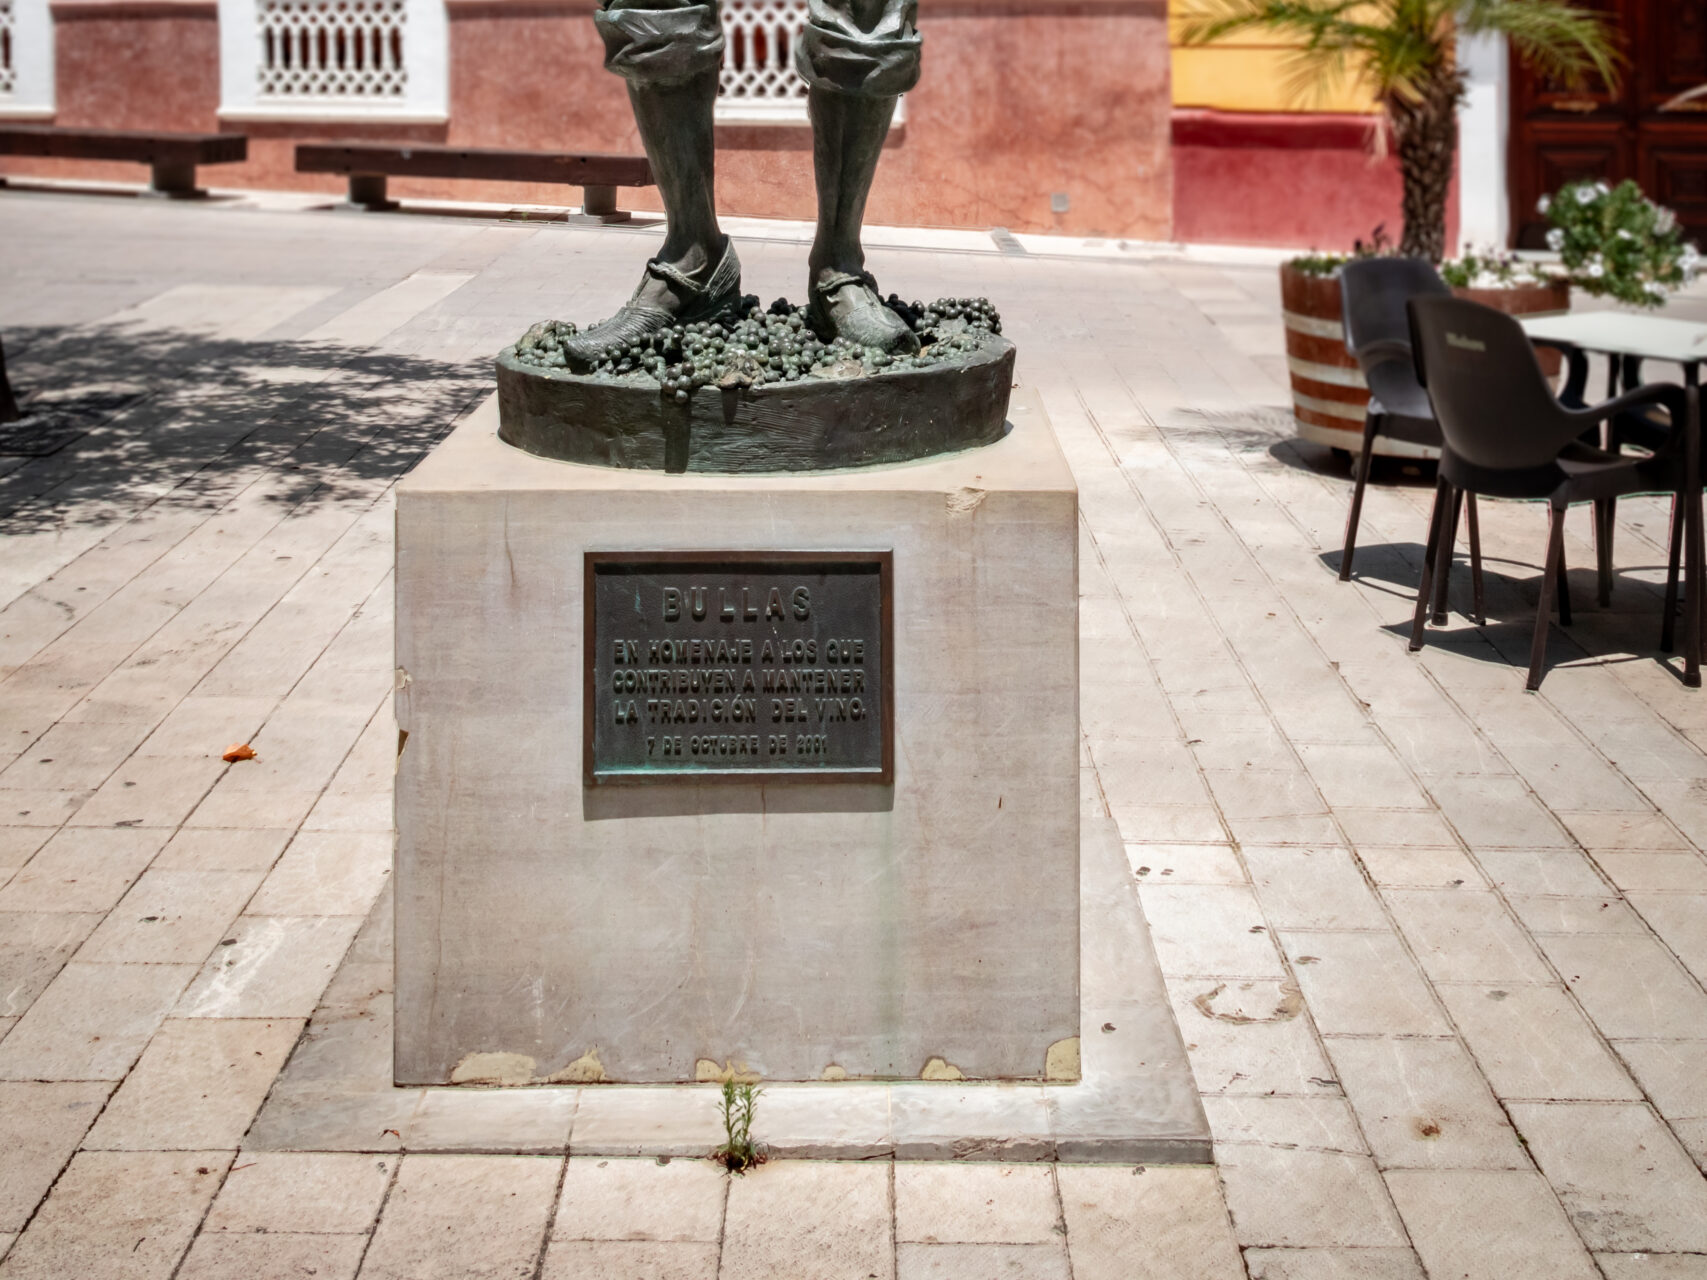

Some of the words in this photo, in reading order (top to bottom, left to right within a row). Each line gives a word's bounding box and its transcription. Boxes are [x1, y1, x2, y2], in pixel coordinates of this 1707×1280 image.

[663, 586, 811, 620] BULLAS
[614, 639, 639, 663] EN
[648, 639, 752, 663] HOMENAJE
[761, 639, 774, 663] A
[782, 639, 817, 663] LOS
[826, 638, 864, 663] QUE
[613, 669, 736, 693] CONTRIBUYEN
[742, 669, 755, 693] A
[761, 669, 865, 693] MANTENER
[614, 699, 639, 724] LA
[647, 693, 756, 724] TRADICIÓN
[771, 699, 808, 722] DEL
[647, 736, 656, 756] 7
[663, 736, 682, 756] DE
[690, 735, 759, 755] OCTUBRE
[769, 735, 787, 754] DE
